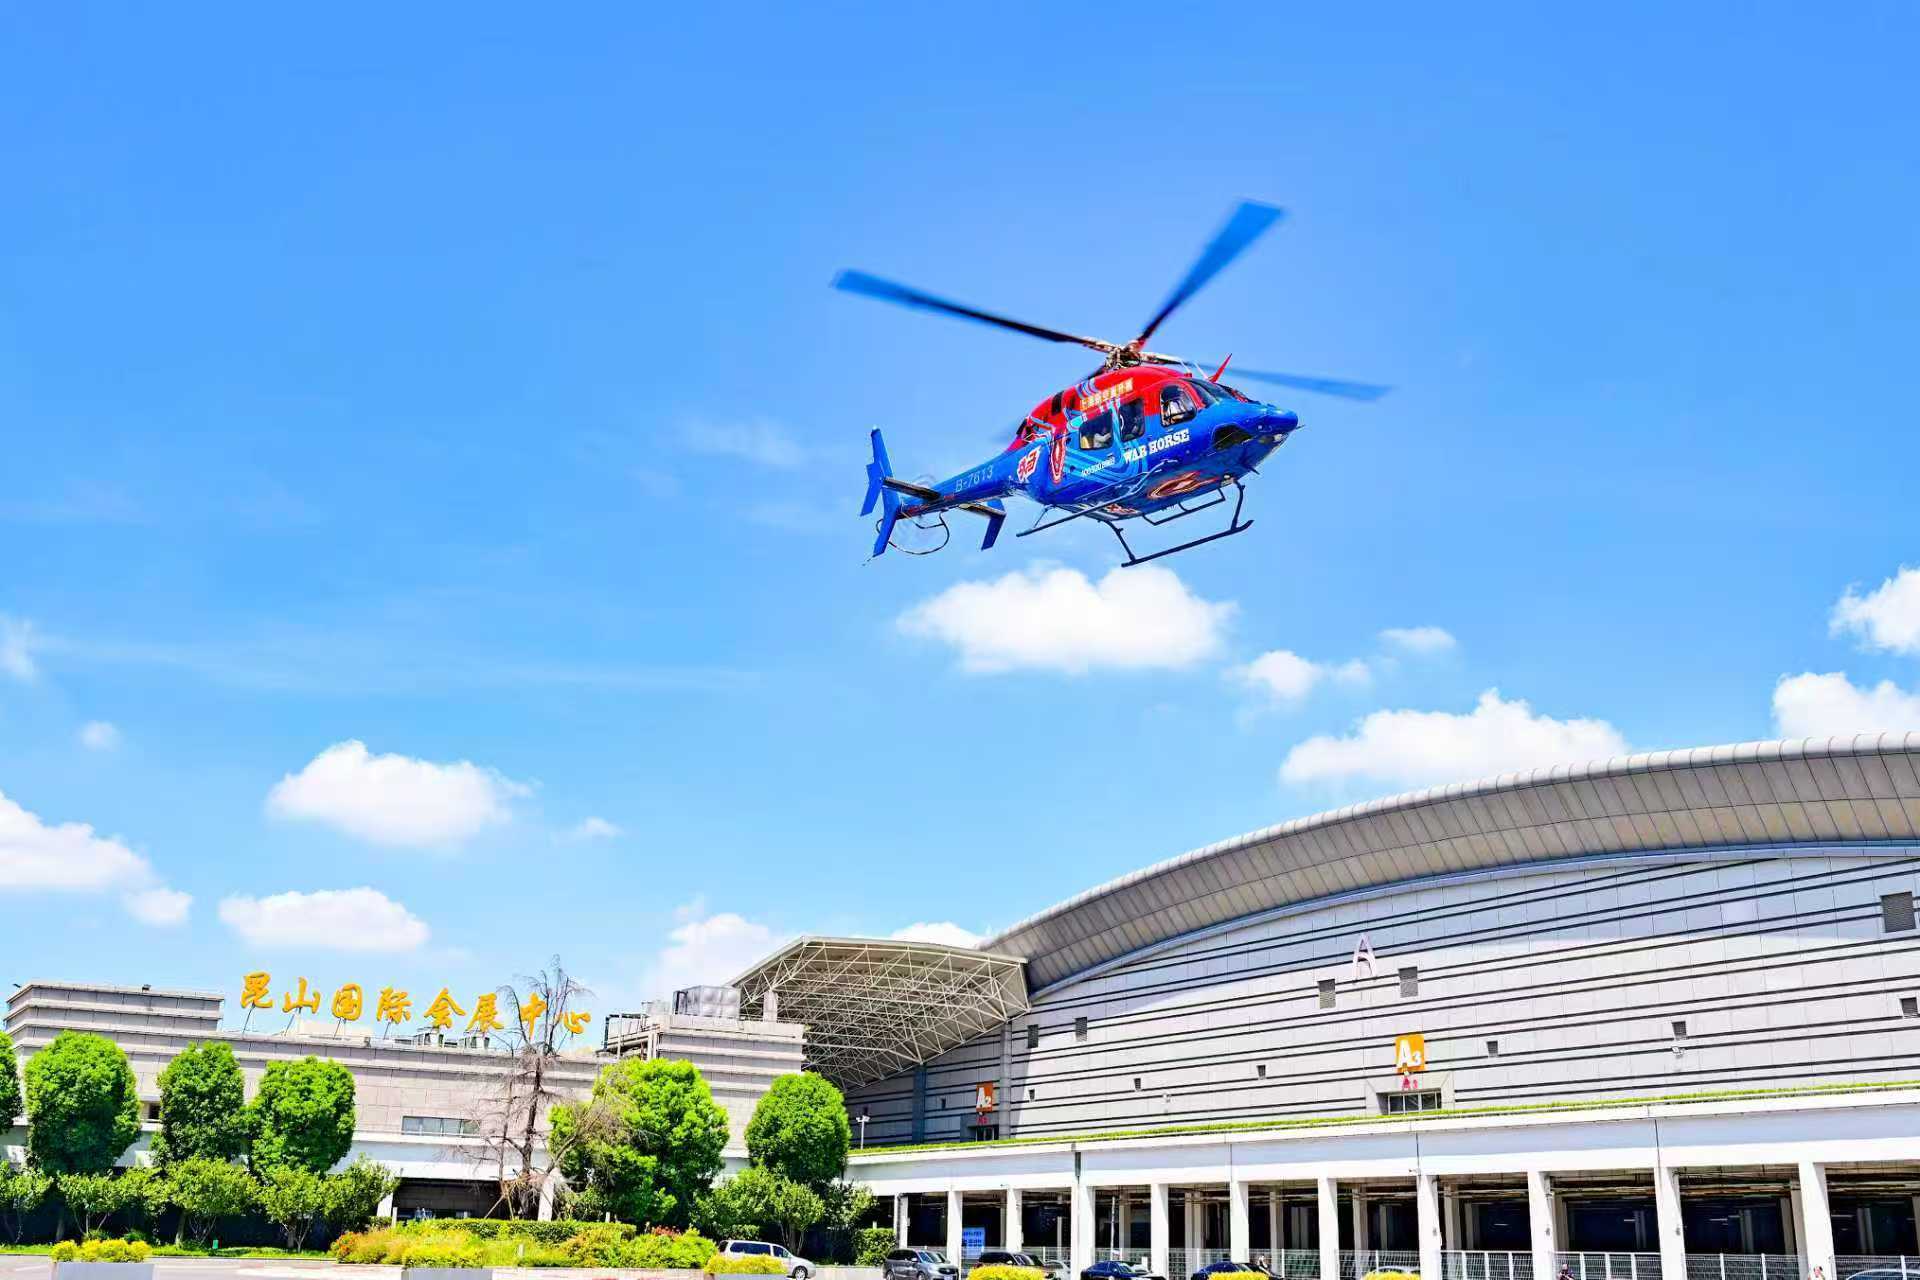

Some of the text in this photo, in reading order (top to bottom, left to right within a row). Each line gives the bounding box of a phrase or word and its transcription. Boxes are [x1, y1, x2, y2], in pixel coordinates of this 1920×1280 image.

[1123, 428, 1190, 464] WAR HORSE
[240, 971, 591, 1037] 昆山国际会展中心
[1396, 1039, 1421, 1068] A3
[976, 1086, 992, 1109] A2
